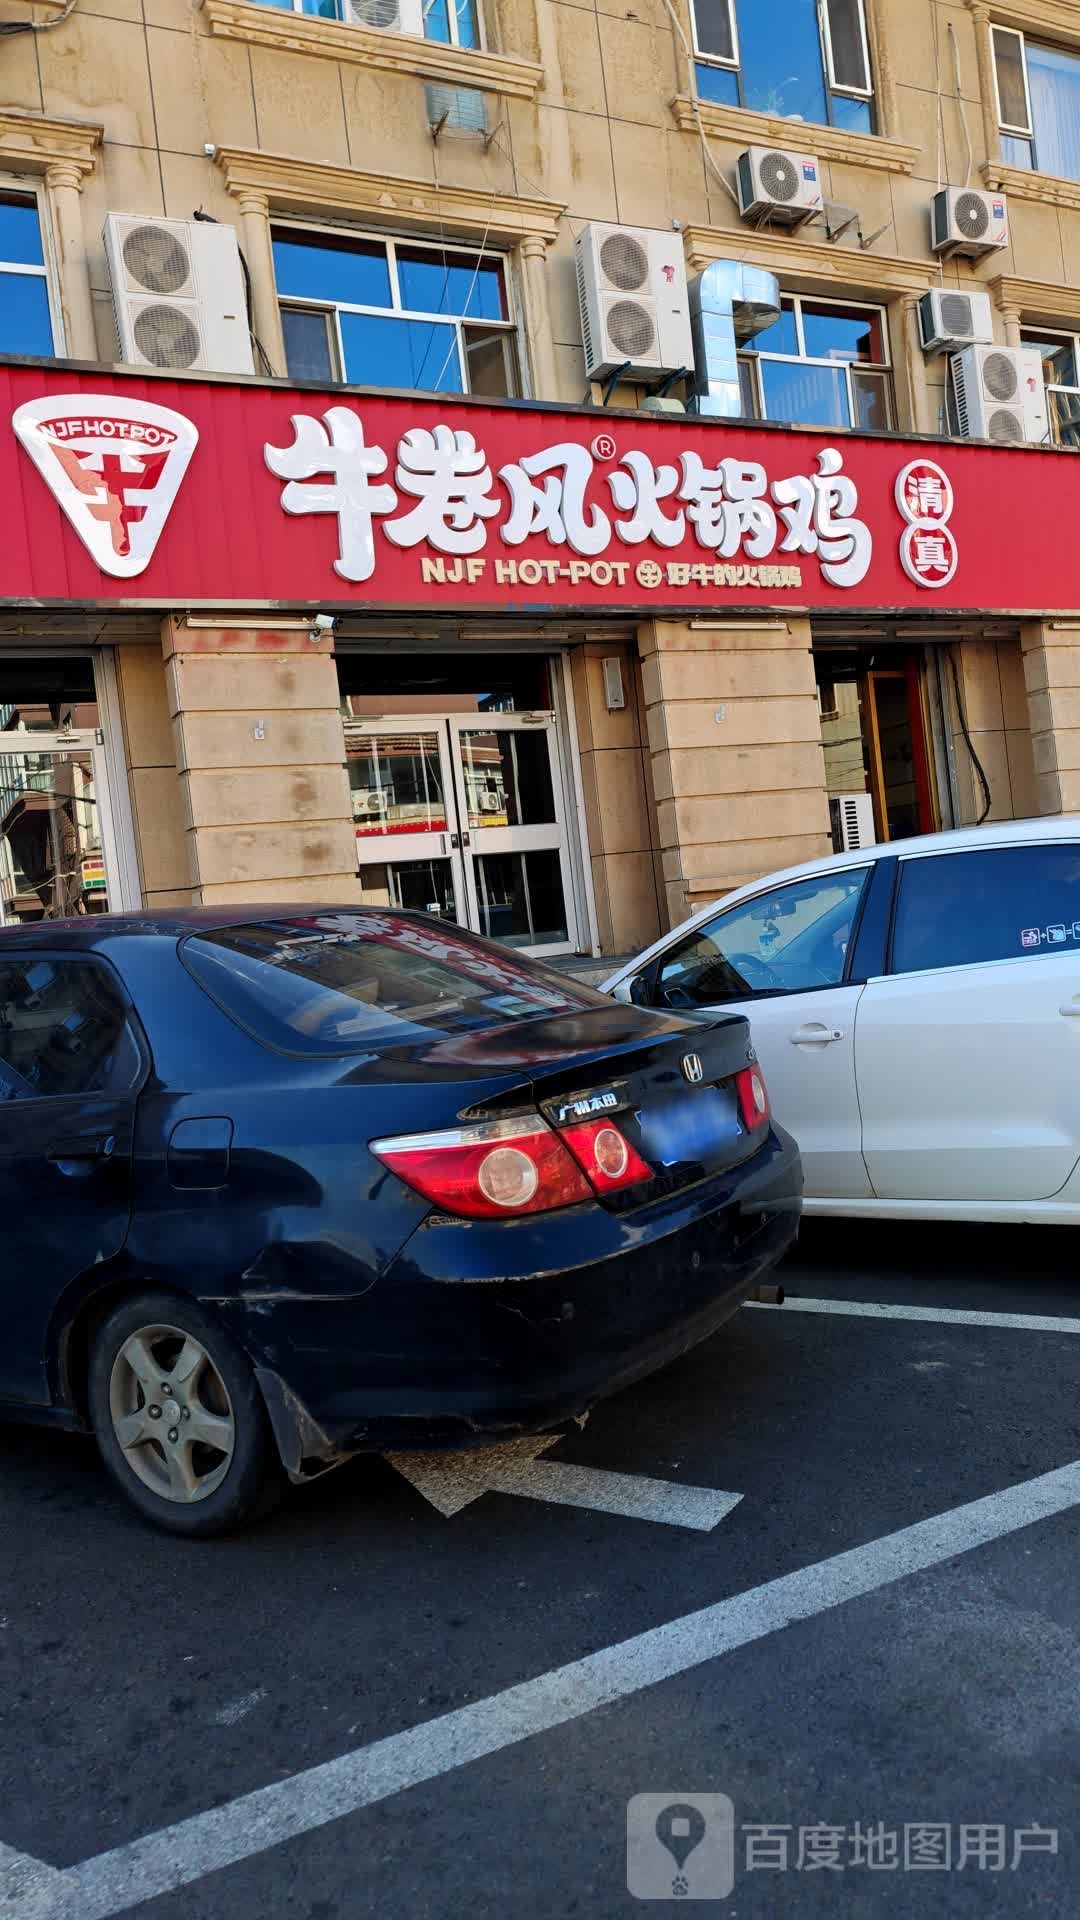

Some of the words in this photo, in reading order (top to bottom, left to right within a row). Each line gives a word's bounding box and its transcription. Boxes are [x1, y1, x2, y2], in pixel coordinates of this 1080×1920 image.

[264, 406, 872, 588] 牛卷风火锅鸡
[907, 475, 950, 573] 清真
[420, 557, 487, 584] NJF
[494, 558, 631, 587] HOT-POT
[559, 1093, 618, 1121] 广州本田
